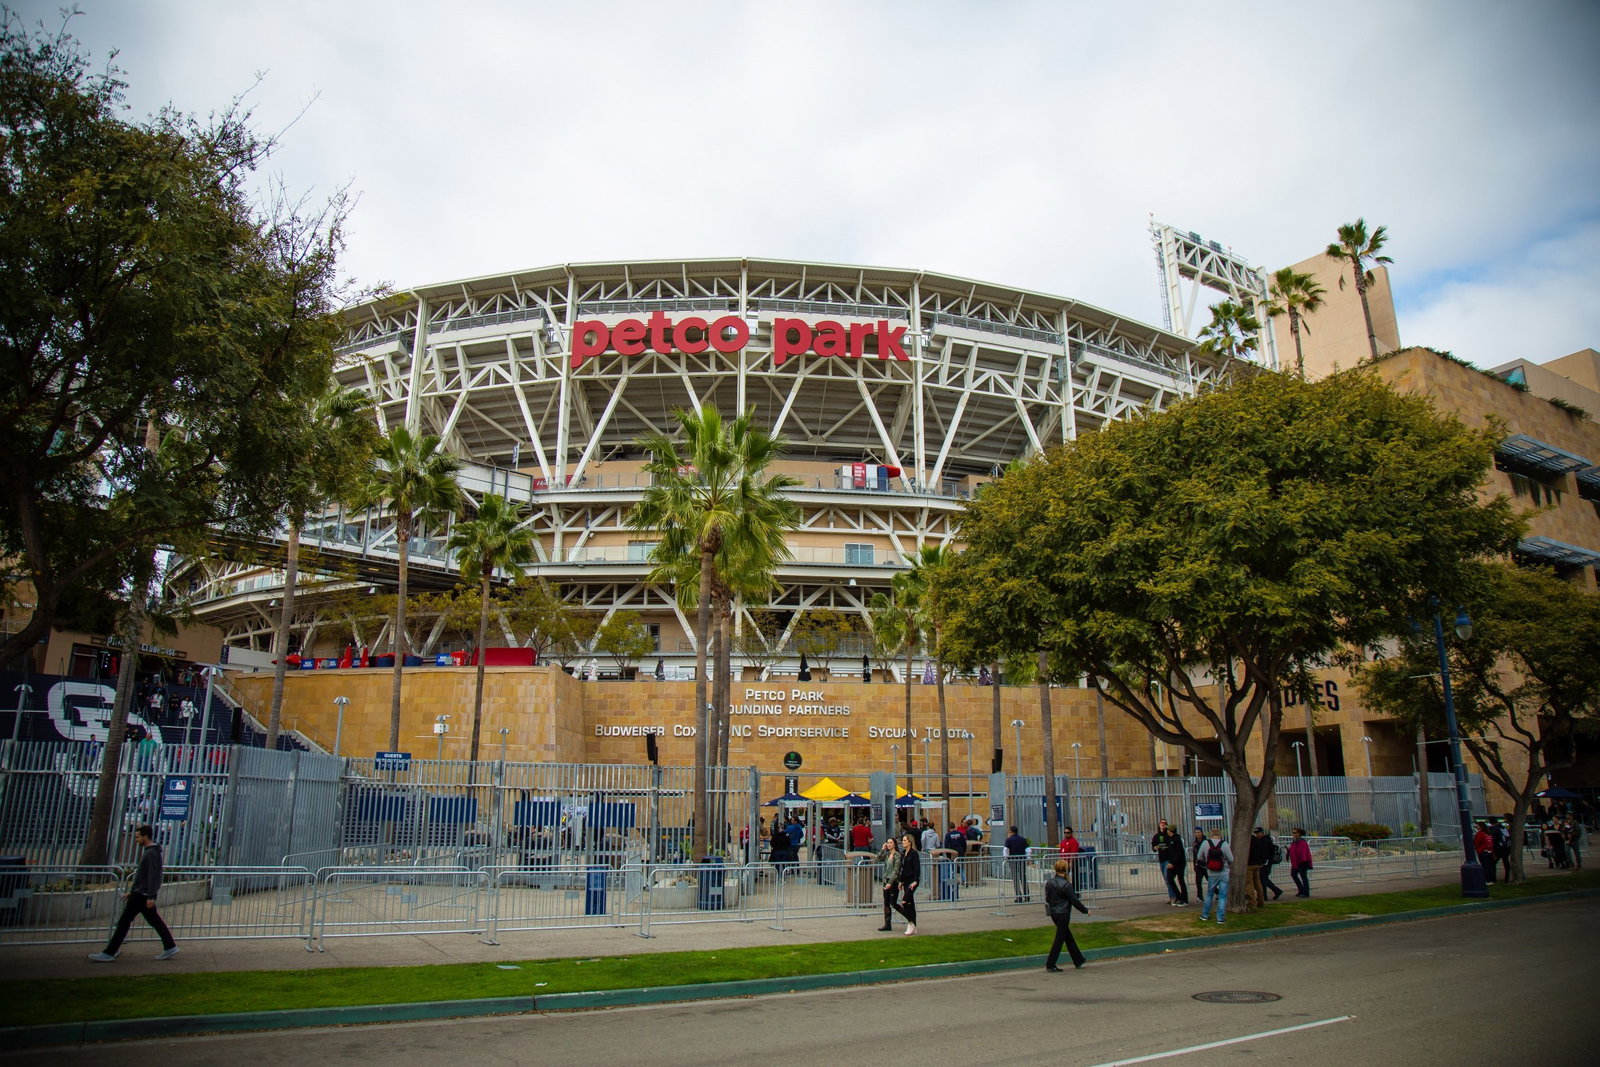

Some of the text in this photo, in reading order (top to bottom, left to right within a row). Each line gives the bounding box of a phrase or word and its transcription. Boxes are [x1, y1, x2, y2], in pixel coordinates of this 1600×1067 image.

[571, 310, 912, 369] petco park
[745, 688, 825, 702] PETCO PARK
[729, 704, 851, 716] OUNDING PARTNERS
[594, 724, 665, 737] BUDWEISER
[731, 724, 752, 738] NC
[758, 725, 849, 738] SPORTSERVICE
[868, 726, 917, 738] SYCUAN
[925, 726, 968, 739] TOOTA
